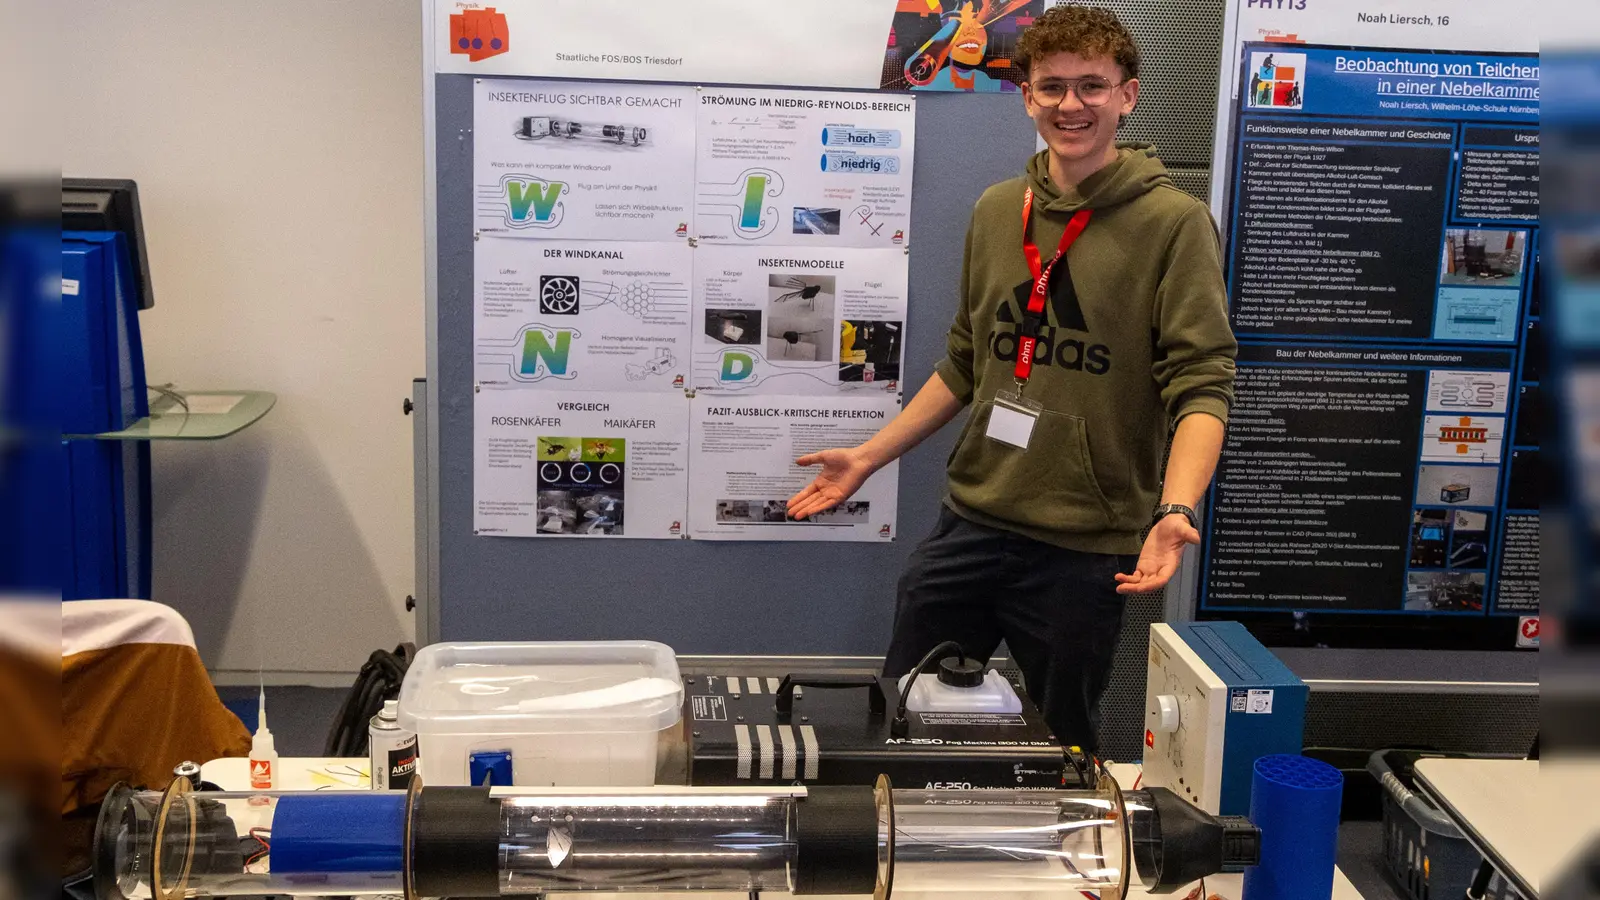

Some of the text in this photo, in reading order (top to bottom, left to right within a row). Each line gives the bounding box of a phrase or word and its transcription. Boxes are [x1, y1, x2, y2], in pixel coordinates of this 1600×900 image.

[1357, 12, 1449, 26] Noah Liersch, 16
[556, 53, 682, 66] Staatliche FOS/BOS Triesdorf
[1335, 57, 1439, 76] Beobachtung
[1444, 64, 1472, 76] von
[1378, 80, 1390, 93] in
[1396, 82, 1435, 94] einer
[488, 91, 682, 108] INSEKTENFLUG SICHTBAR GEMACHT
[702, 96, 910, 112] STRÖMUNG IM NIEDRIG-REYNOLDS-BEREICH
[1400, 101, 1430, 110] Liersch,
[1431, 103, 1508, 113] Wilhelm-Löhe-Schule
[848, 133, 876, 144] hoch
[1246, 125, 1308, 134] Funktionsweise
[1310, 127, 1330, 135] einer
[1332, 128, 1388, 137] Nebelkammer
[1406, 130, 1451, 140] Geschichte
[841, 159, 881, 172] niedrig
[544, 249, 624, 259] DER WINDKANAL
[758, 258, 844, 269] INSEKTENMODELLE
[520, 330, 572, 374] N
[988, 324, 1111, 375] ddas
[1308, 350, 1362, 359] Nebelkammer
[1410, 354, 1462, 362] Informationen
[721, 352, 753, 380] D
[557, 403, 610, 411] VERGLEICH
[708, 407, 884, 419] FAZIT-AUSBLICK-KRITISCHE REFLEKTION
[492, 416, 561, 427] ROSENKÄFER
[604, 419, 656, 429] MAIKÄFER
